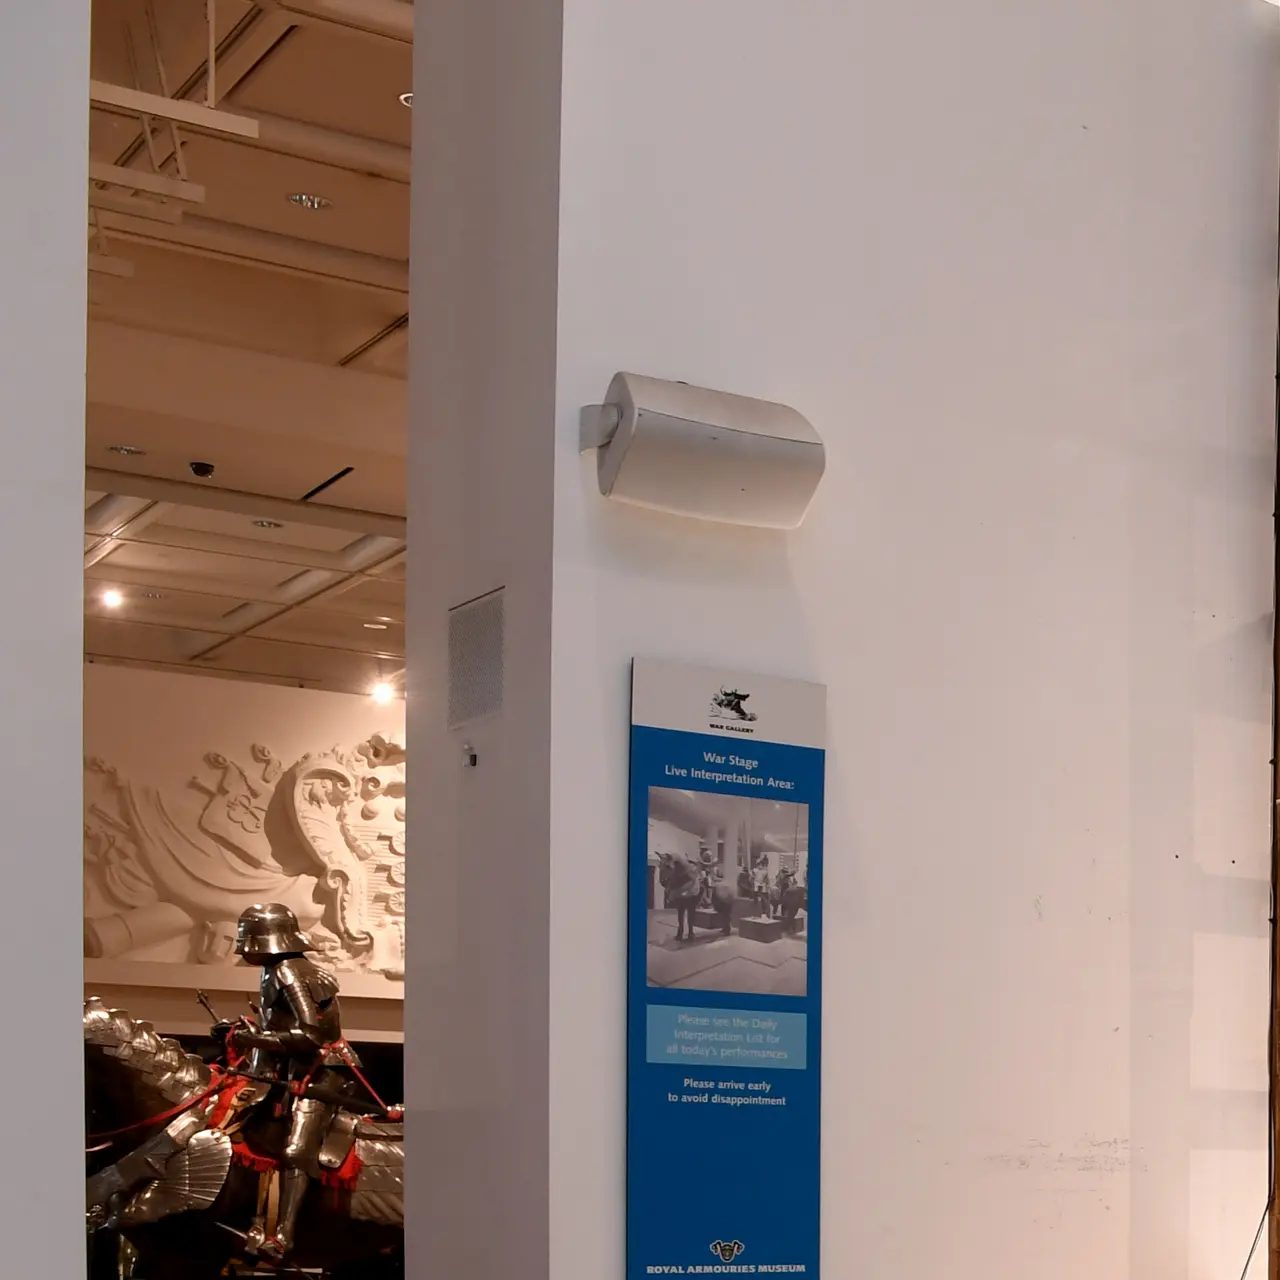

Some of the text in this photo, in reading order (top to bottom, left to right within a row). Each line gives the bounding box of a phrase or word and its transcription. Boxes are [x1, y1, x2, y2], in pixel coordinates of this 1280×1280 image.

[703, 751, 758, 770] War Stage
[665, 765, 795, 790] Live Interpretation Area:
[678, 1013, 777, 1031] Please see the Daily
[674, 1029, 780, 1044] Interpretation List for
[666, 1044, 788, 1060] all today's performances
[683, 1078, 771, 1093] Please arrive early
[668, 1093, 786, 1107] to avoid disappointment
[646, 1264, 806, 1274] ROYAL ARMOURIES MUSEUM
